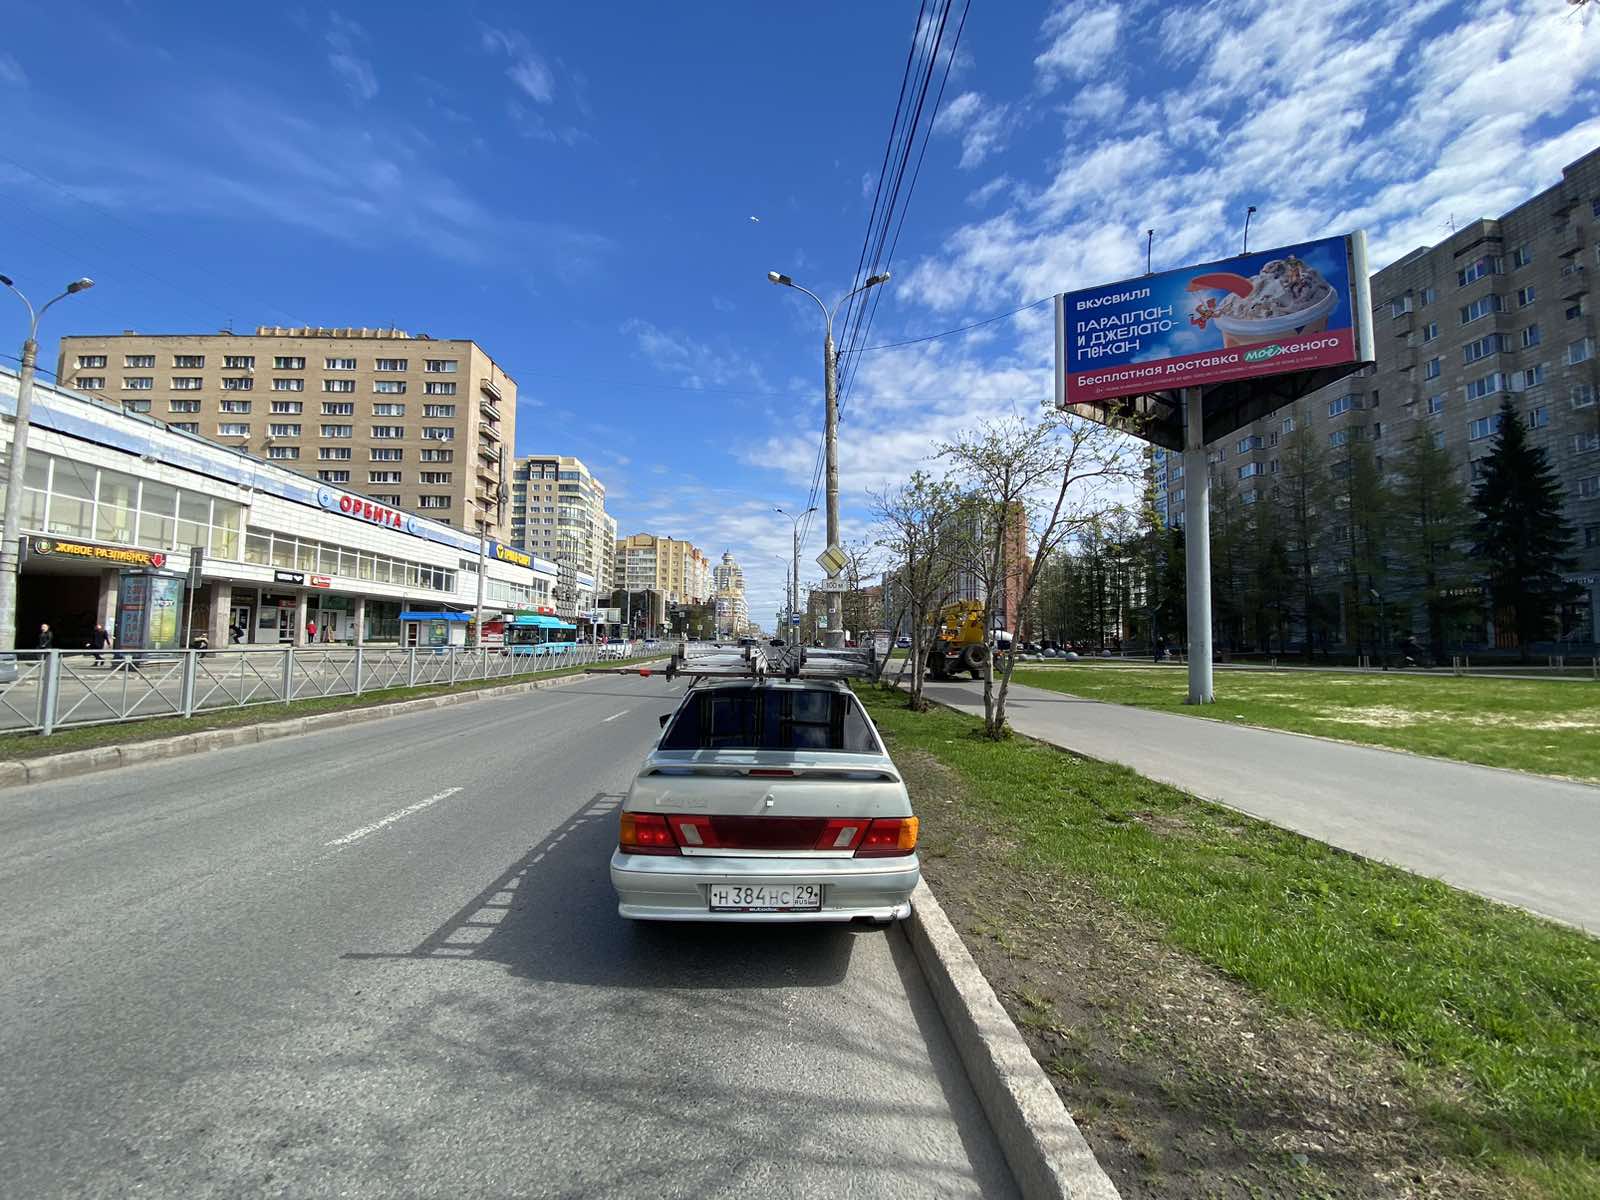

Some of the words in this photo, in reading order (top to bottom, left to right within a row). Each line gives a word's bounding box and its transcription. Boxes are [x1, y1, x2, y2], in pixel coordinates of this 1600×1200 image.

[1076, 288, 1151, 311] ВКУСВИЛЛ
[1077, 335, 1086, 347] И
[1078, 365, 1162, 387] Бесплатная
[1166, 353, 1239, 374] доставка
[339, 495, 402, 528] ОРБИТА
[55, 542, 93, 556] ЖИВОЕ
[95, 547, 150, 562] РАЗЛИВНОЕ
[796, 886, 814, 899] 29
